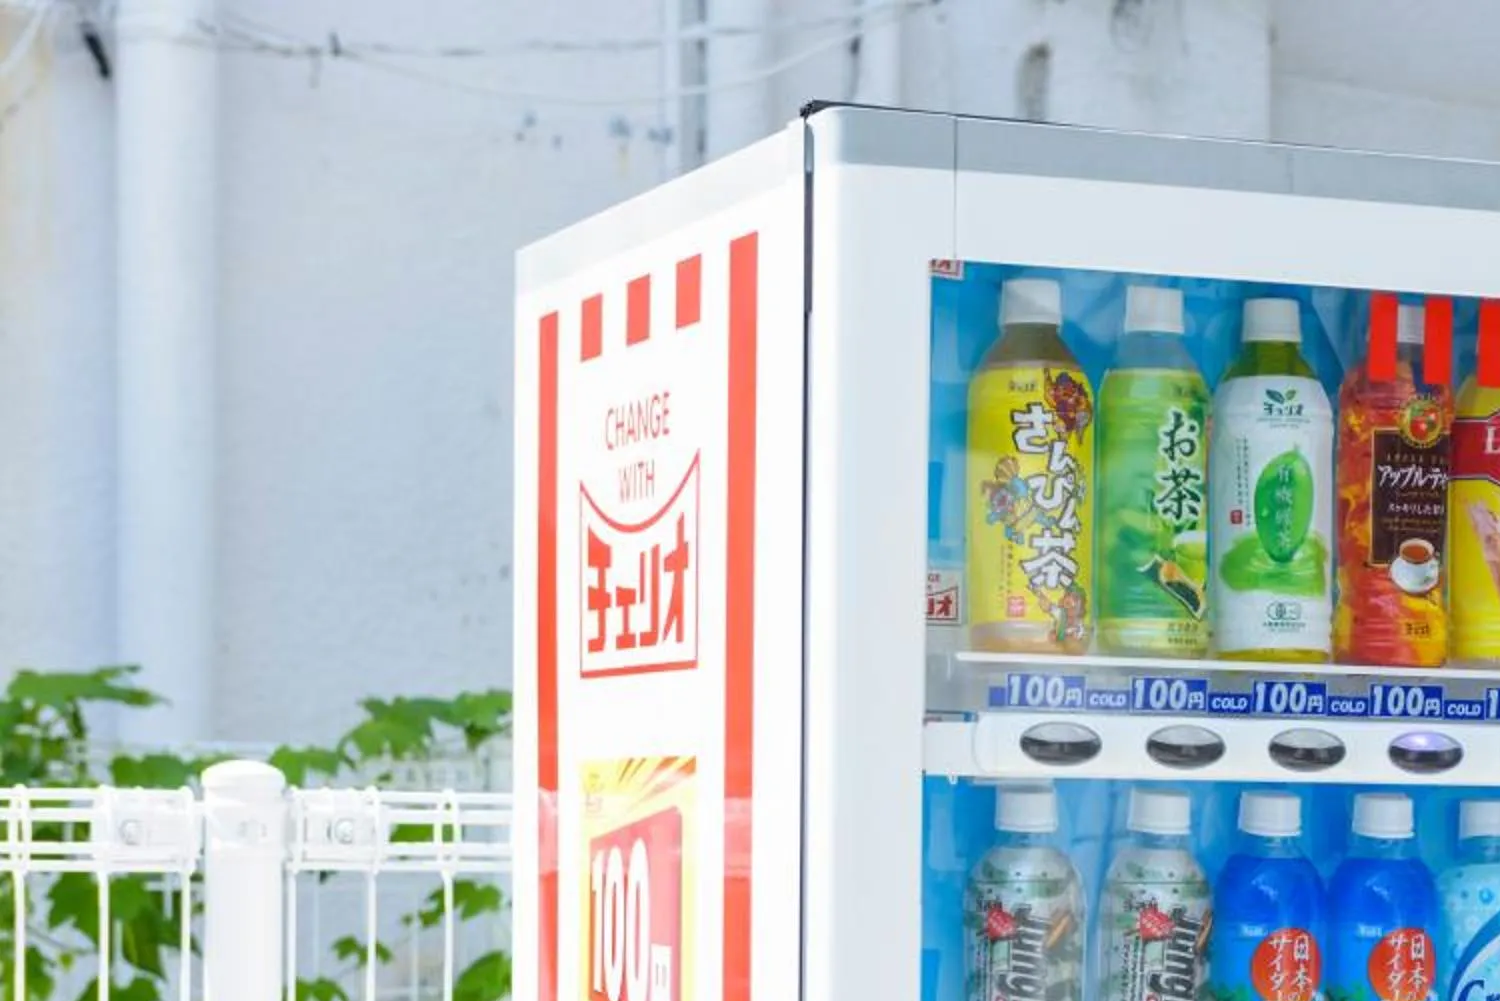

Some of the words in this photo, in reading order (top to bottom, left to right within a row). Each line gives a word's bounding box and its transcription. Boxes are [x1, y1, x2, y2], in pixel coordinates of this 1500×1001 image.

[605, 391, 670, 451] CHANGE
[1156, 409, 1201, 521] お茶
[618, 459, 656, 504] WITH
[1010, 401, 1079, 589] さんぴん茶
[588, 511, 689, 654] チェリオ
[1008, 675, 1083, 707] 100円
[1089, 692, 1127, 706] COLD
[1133, 678, 1205, 710] 100円
[1211, 696, 1249, 710] COLD
[1255, 682, 1324, 713] 100円
[1330, 699, 1365, 713] COLD
[1372, 686, 1441, 716] 100円
[1447, 703, 1482, 716] COLD
